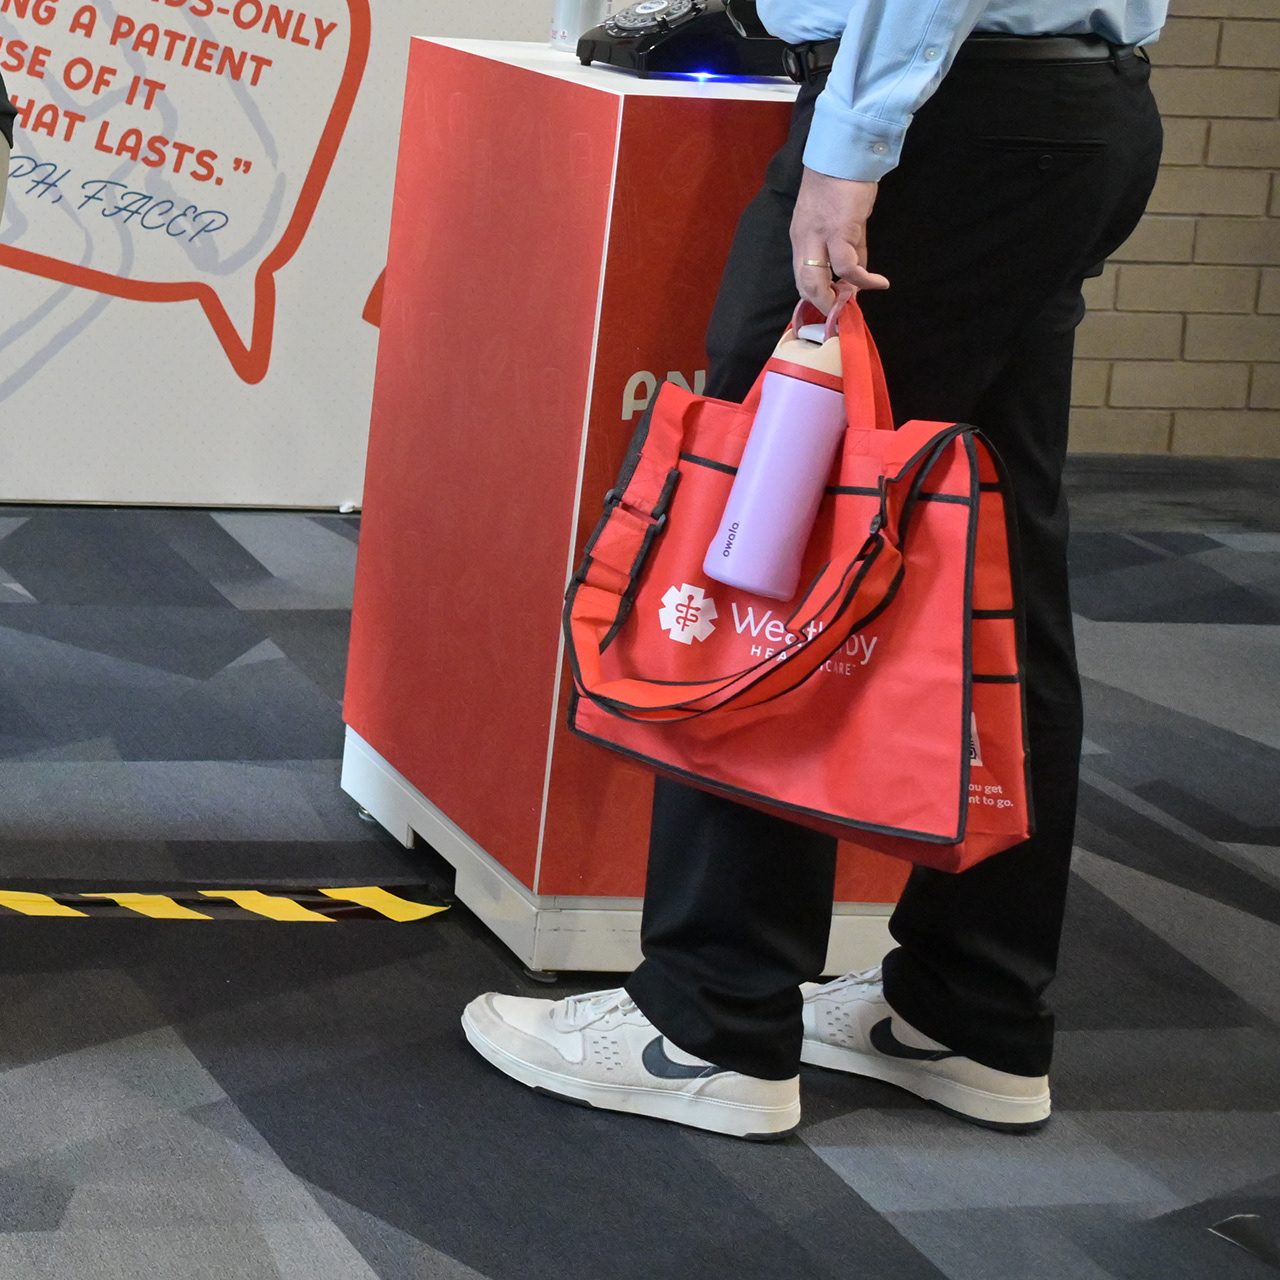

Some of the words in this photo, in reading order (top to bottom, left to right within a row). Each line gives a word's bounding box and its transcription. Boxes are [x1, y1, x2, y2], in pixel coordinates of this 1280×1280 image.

[69, 5, 97, 38] A
[110, 16, 273, 86] PATIENT
[63, 57, 117, 95] OF
[126, 76, 166, 110] IT
[6, 95, 86, 143] HAT
[78, 178, 229, 244] FACEP
[722, 521, 739, 558] owala
[982, 796, 994, 805] to
[997, 799, 1013, 808] go.
[984, 785, 1002, 794] get
